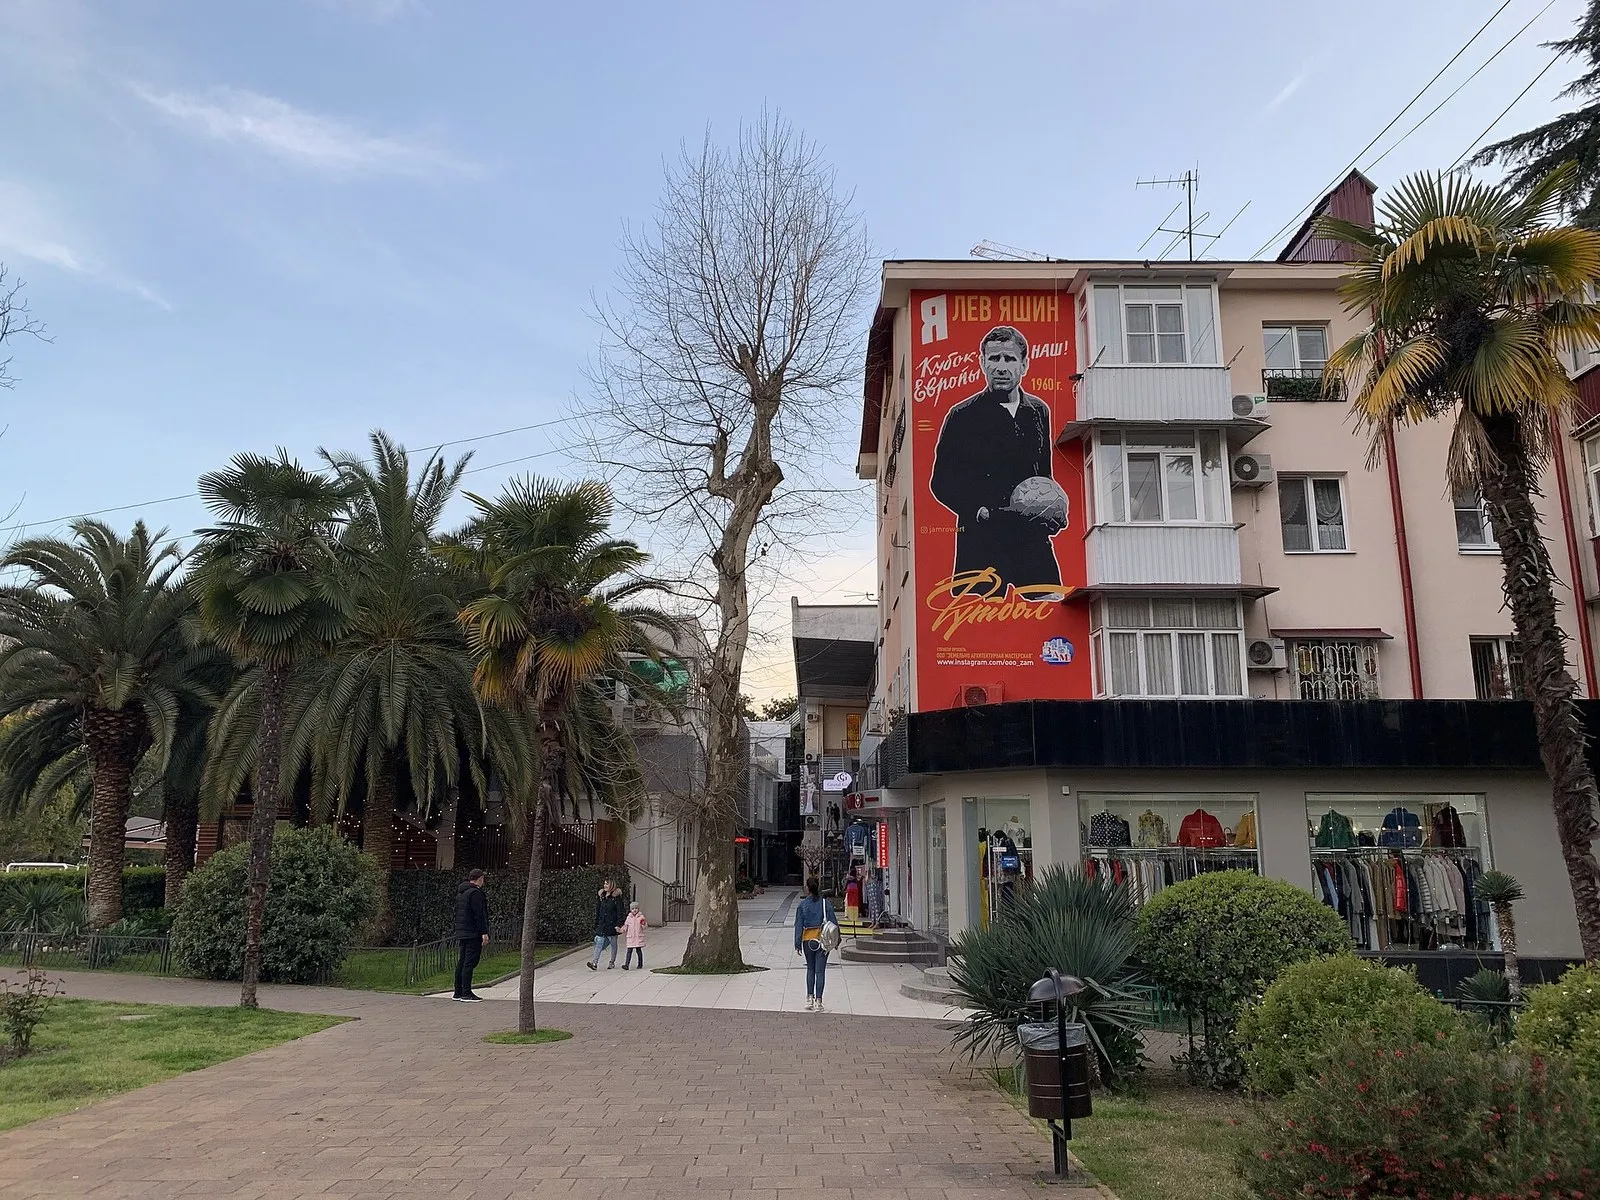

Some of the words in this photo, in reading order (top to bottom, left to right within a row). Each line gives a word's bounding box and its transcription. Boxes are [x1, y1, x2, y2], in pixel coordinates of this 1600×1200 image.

[920, 293, 949, 345] Я
[952, 295, 992, 322] ЛЕВ
[999, 295, 1059, 322] ЯШИН
[1031, 340, 1069, 360] НАШ!
[915, 351, 978, 379] Кубок
[1031, 377, 1054, 391] 1960
[1056, 381, 1063, 391] г.
[936, 659, 1034, 667] www.instagram.com/ooo_zam
